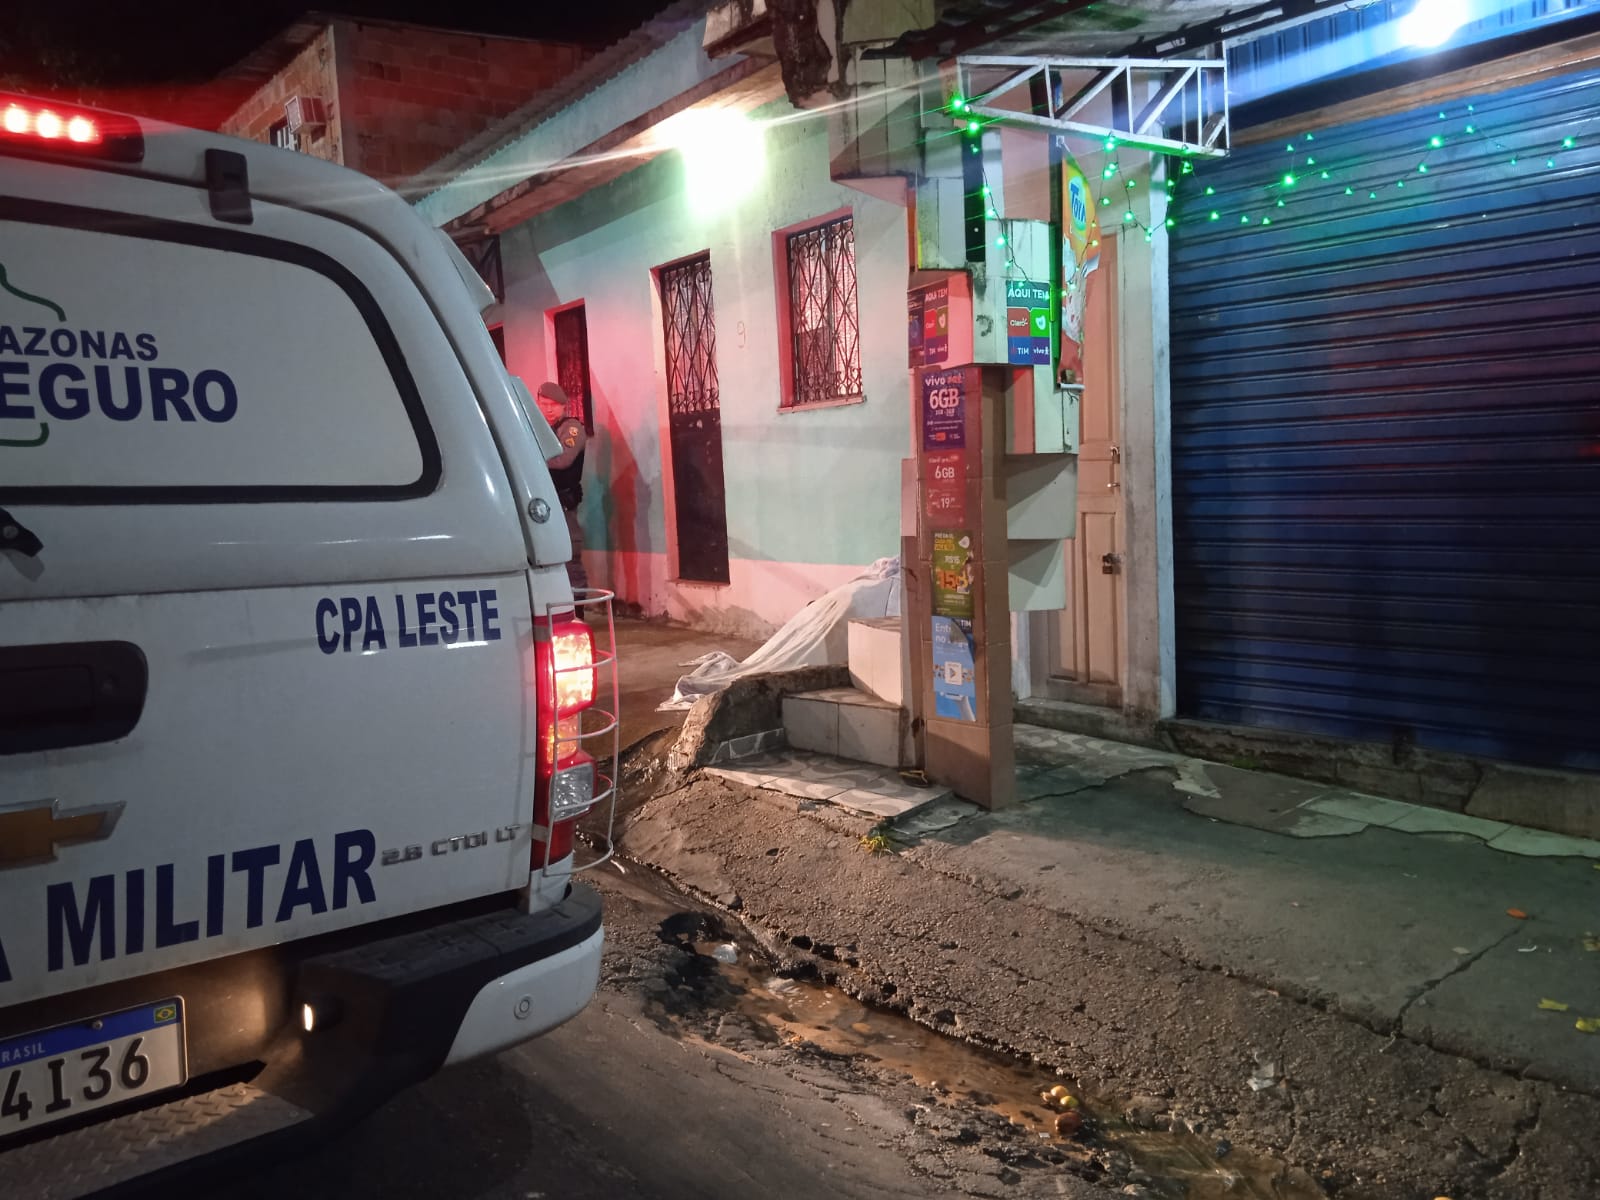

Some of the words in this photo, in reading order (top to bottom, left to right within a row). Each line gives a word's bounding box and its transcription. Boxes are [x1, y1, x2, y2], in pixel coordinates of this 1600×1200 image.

[1008, 288, 1031, 298] AQUI
[1017, 347, 1029, 355] TIM
[925, 375, 946, 386] vivo
[929, 388, 959, 409] 6GB
[935, 465, 955, 479] 6GB
[315, 596, 387, 655] CPA
[396, 589, 501, 648] LESTE
[381, 844, 423, 866] 2.8
[495, 824, 521, 843] LT
[47, 829, 376, 972] MILITAR
